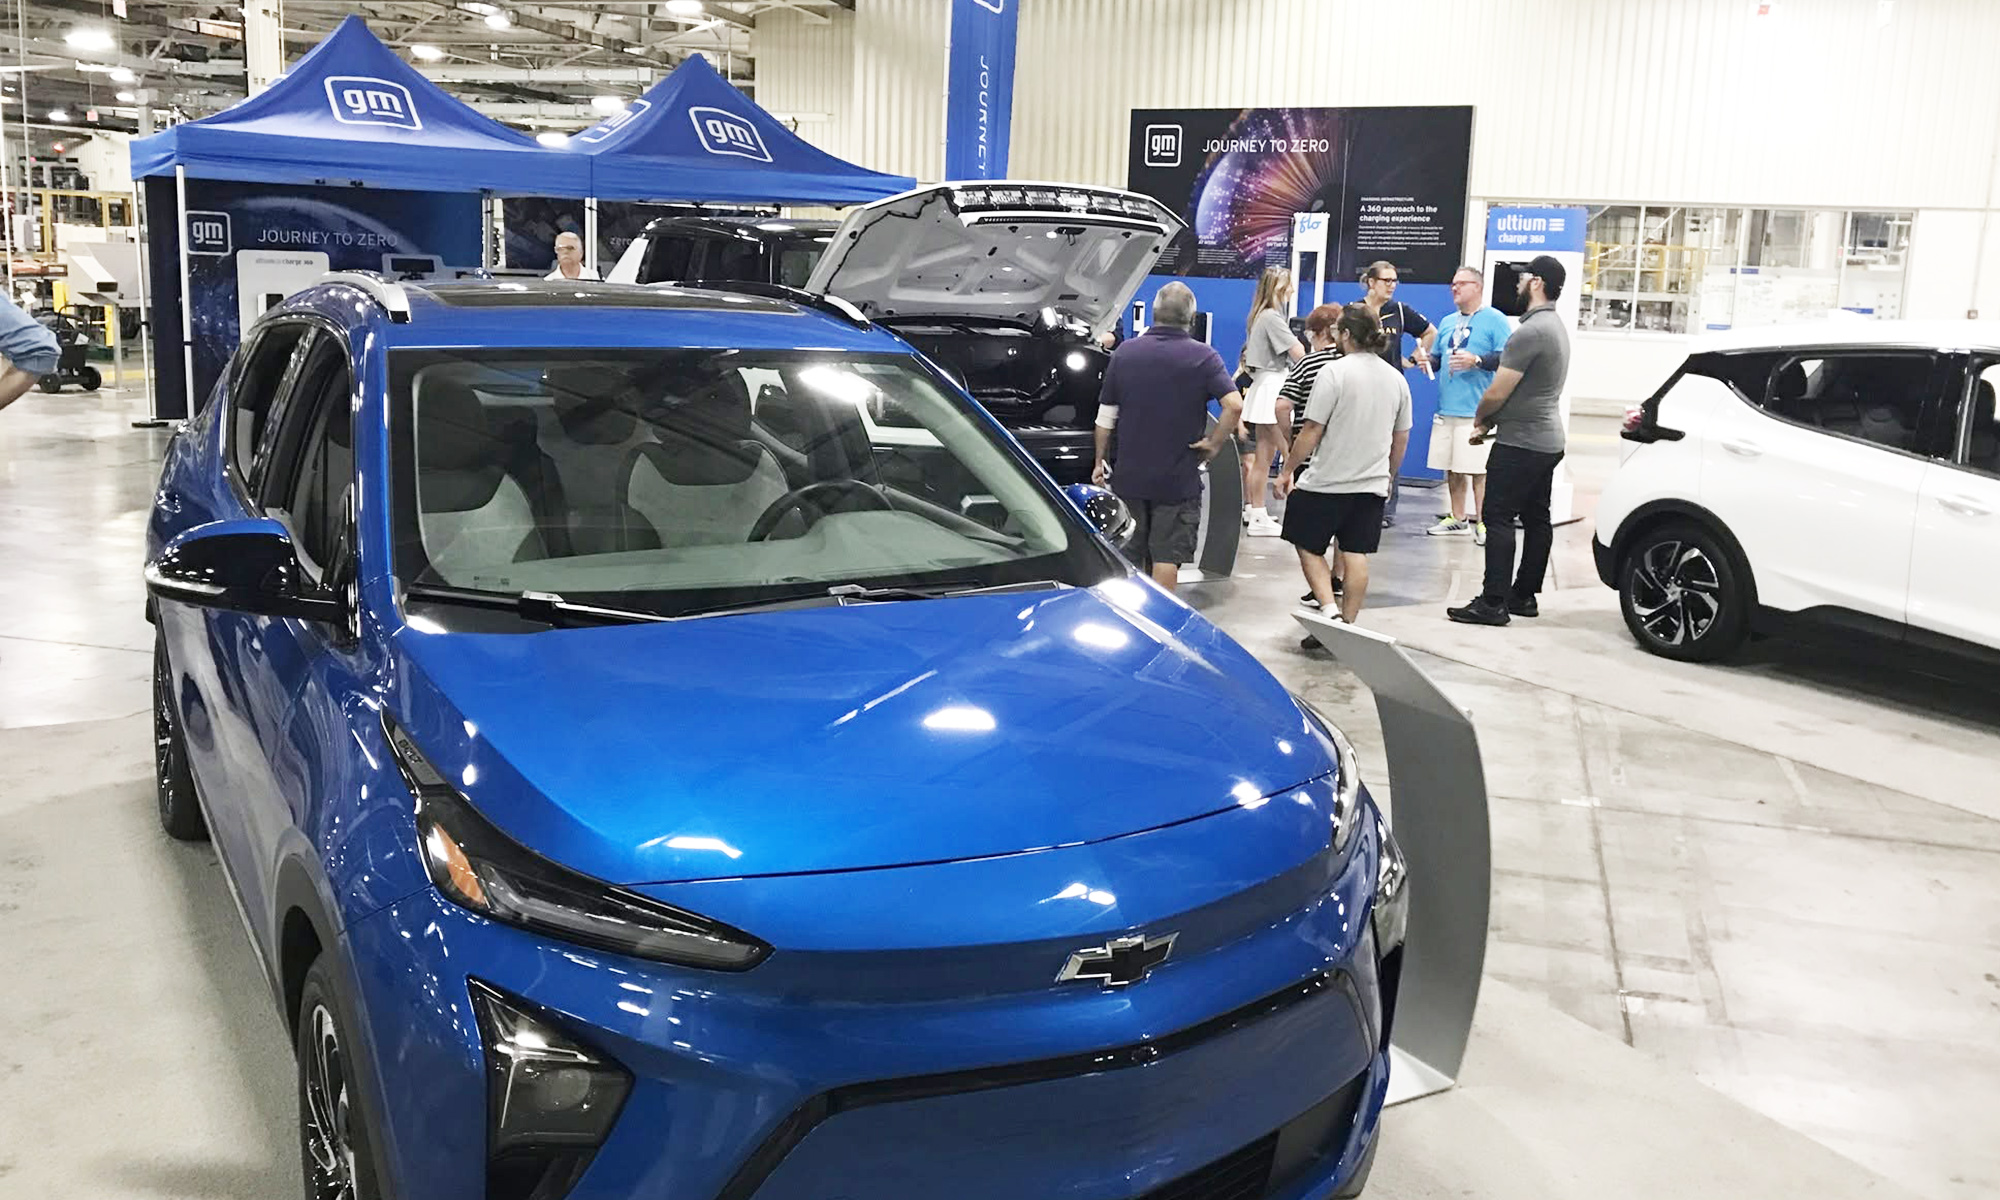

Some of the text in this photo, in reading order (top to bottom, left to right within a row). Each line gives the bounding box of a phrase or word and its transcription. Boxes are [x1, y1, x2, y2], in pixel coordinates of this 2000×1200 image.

[343, 89, 404, 119] gm
[978, 54, 990, 177] JOURNEY
[706, 119, 757, 151] gm
[1151, 134, 1176, 157] gm
[1202, 138, 1329, 153] JOURNEY TO ZERO
[1367, 204, 1381, 213] 360
[1382, 205, 1415, 213] approach
[1416, 205, 1424, 213] to
[1425, 205, 1438, 213] the
[1299, 213, 1321, 233] flo
[1359, 214, 1431, 223] charging experience
[1497, 214, 1546, 231] ultium
[192, 220, 224, 245] gm
[258, 229, 398, 247] JOURNEY TO ZERO
[1498, 232, 1545, 245] charge 360
